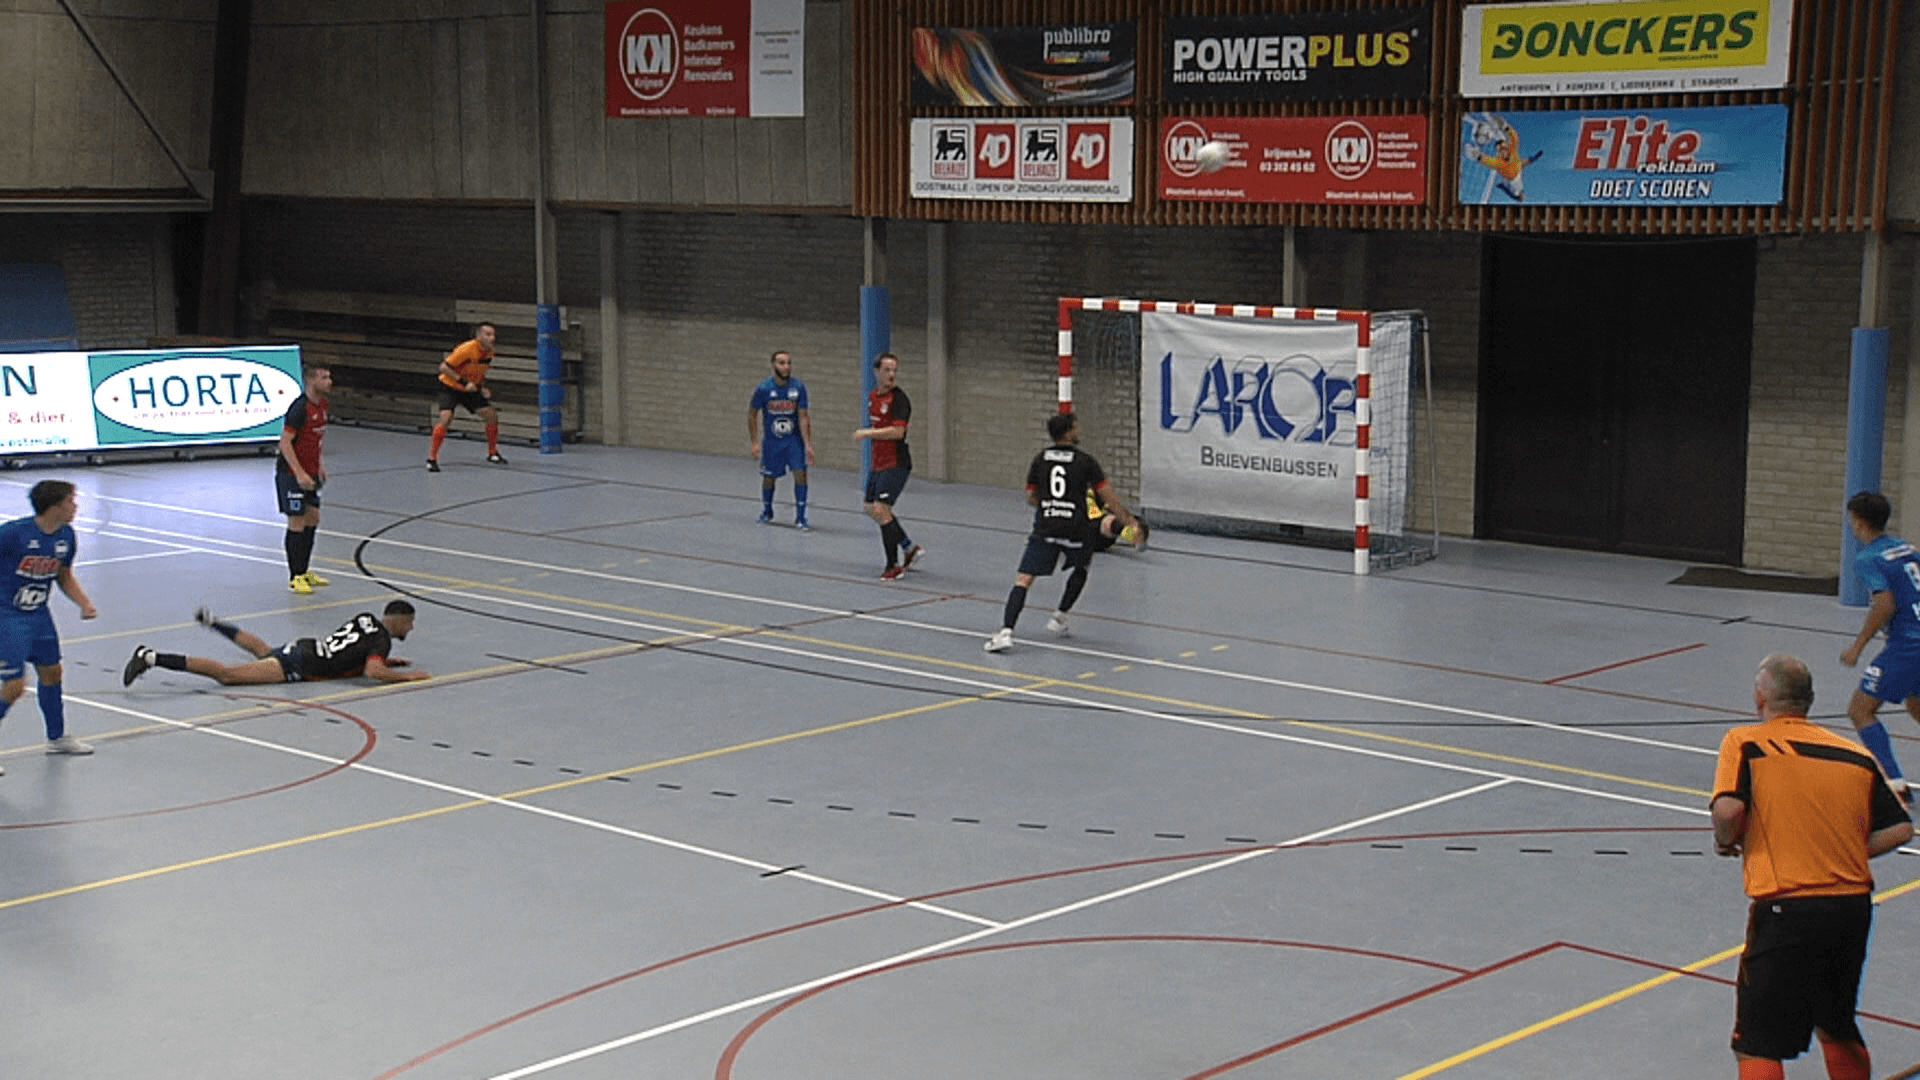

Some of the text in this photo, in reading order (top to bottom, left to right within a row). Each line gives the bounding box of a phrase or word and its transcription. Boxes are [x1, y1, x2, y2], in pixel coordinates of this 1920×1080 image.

[1043, 26, 1111, 60] publibro
[1173, 31, 1411, 70] POWERPLUS
[1491, 10, 1758, 59] DONCKERS
[1173, 69, 1307, 83] HIGH QUALITY TOOLS
[1573, 116, 1700, 170] Elite
[975, 183, 1000, 193] OPEN
[1589, 178, 1713, 199] DOET SCOREN
[129, 373, 271, 409] HORTA
[1051, 465, 1066, 498] 6
